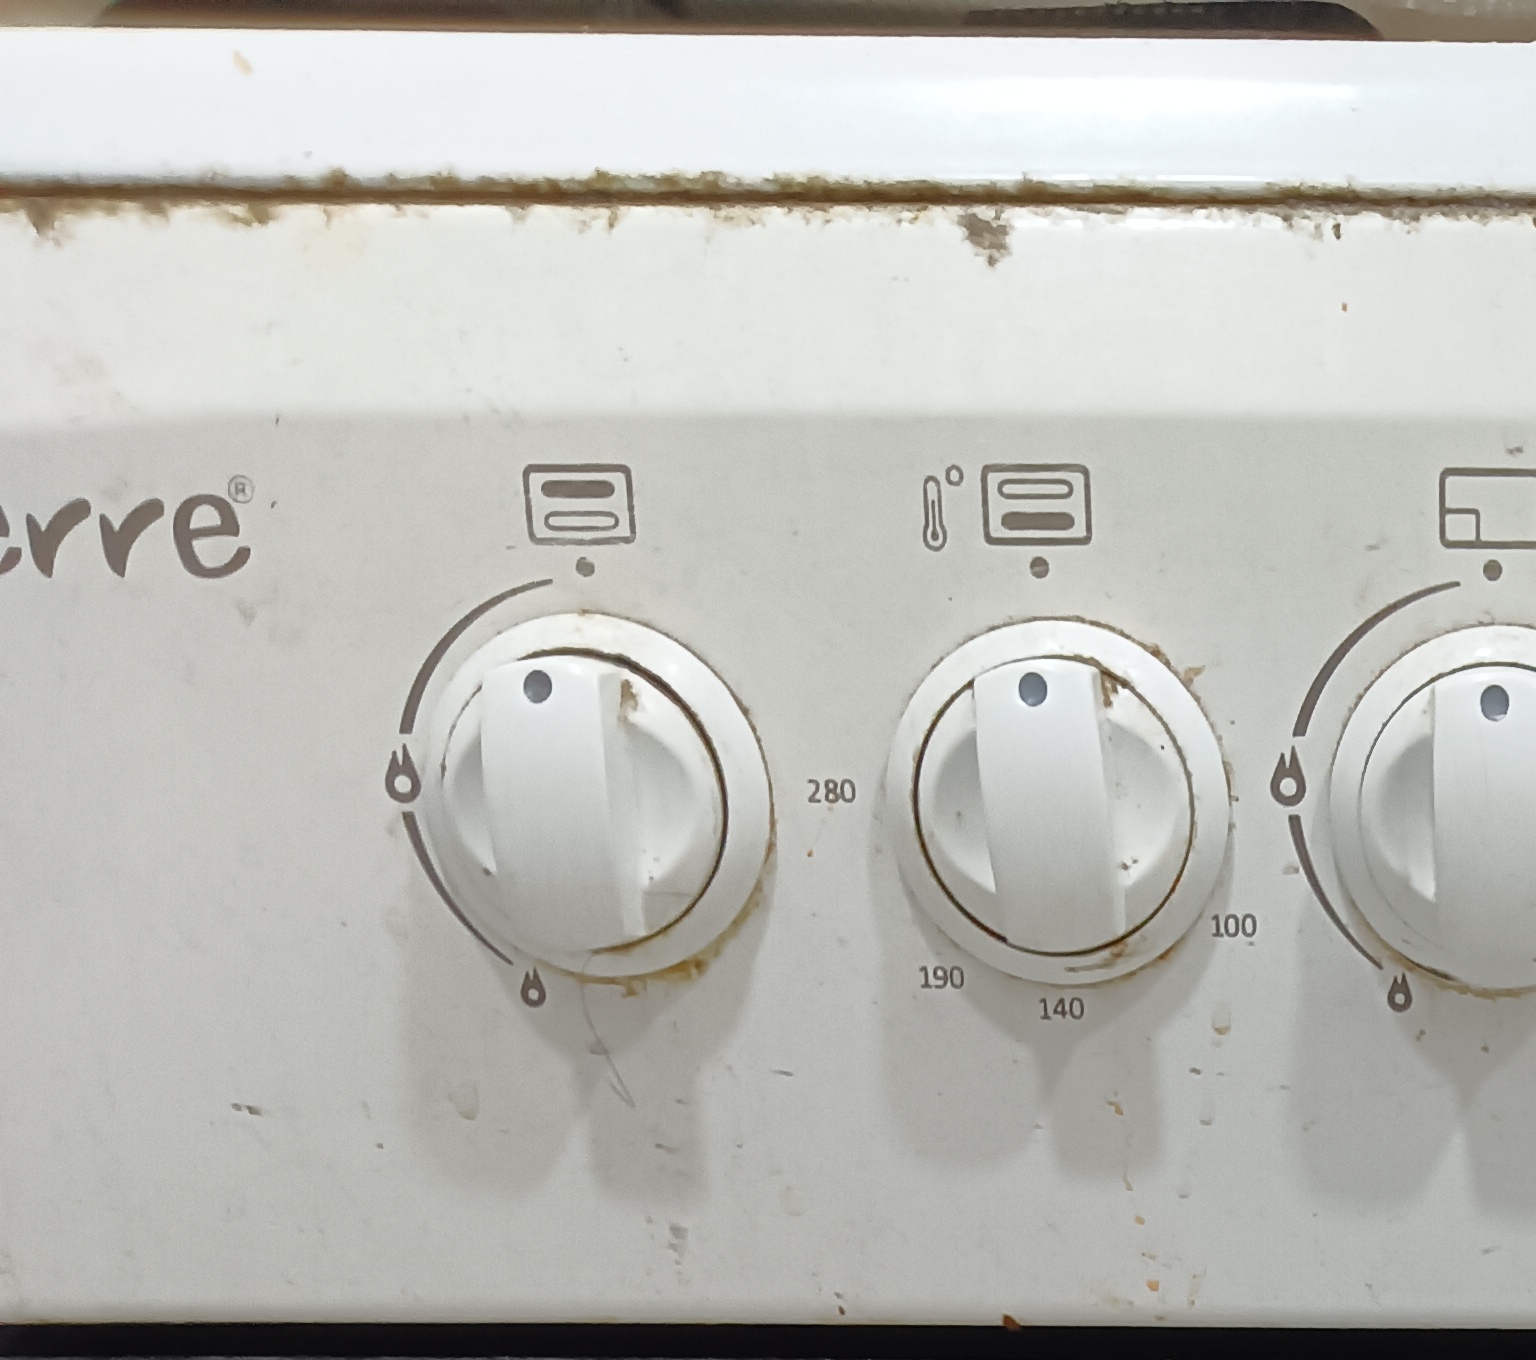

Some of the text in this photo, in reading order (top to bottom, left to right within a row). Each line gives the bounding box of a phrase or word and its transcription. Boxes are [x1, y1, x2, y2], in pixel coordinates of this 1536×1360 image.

[0, 494, 251, 579] rre
[806, 778, 857, 804] 280
[1210, 913, 1258, 938] 100
[919, 965, 966, 990] 190
[1038, 997, 1085, 1021] 140
